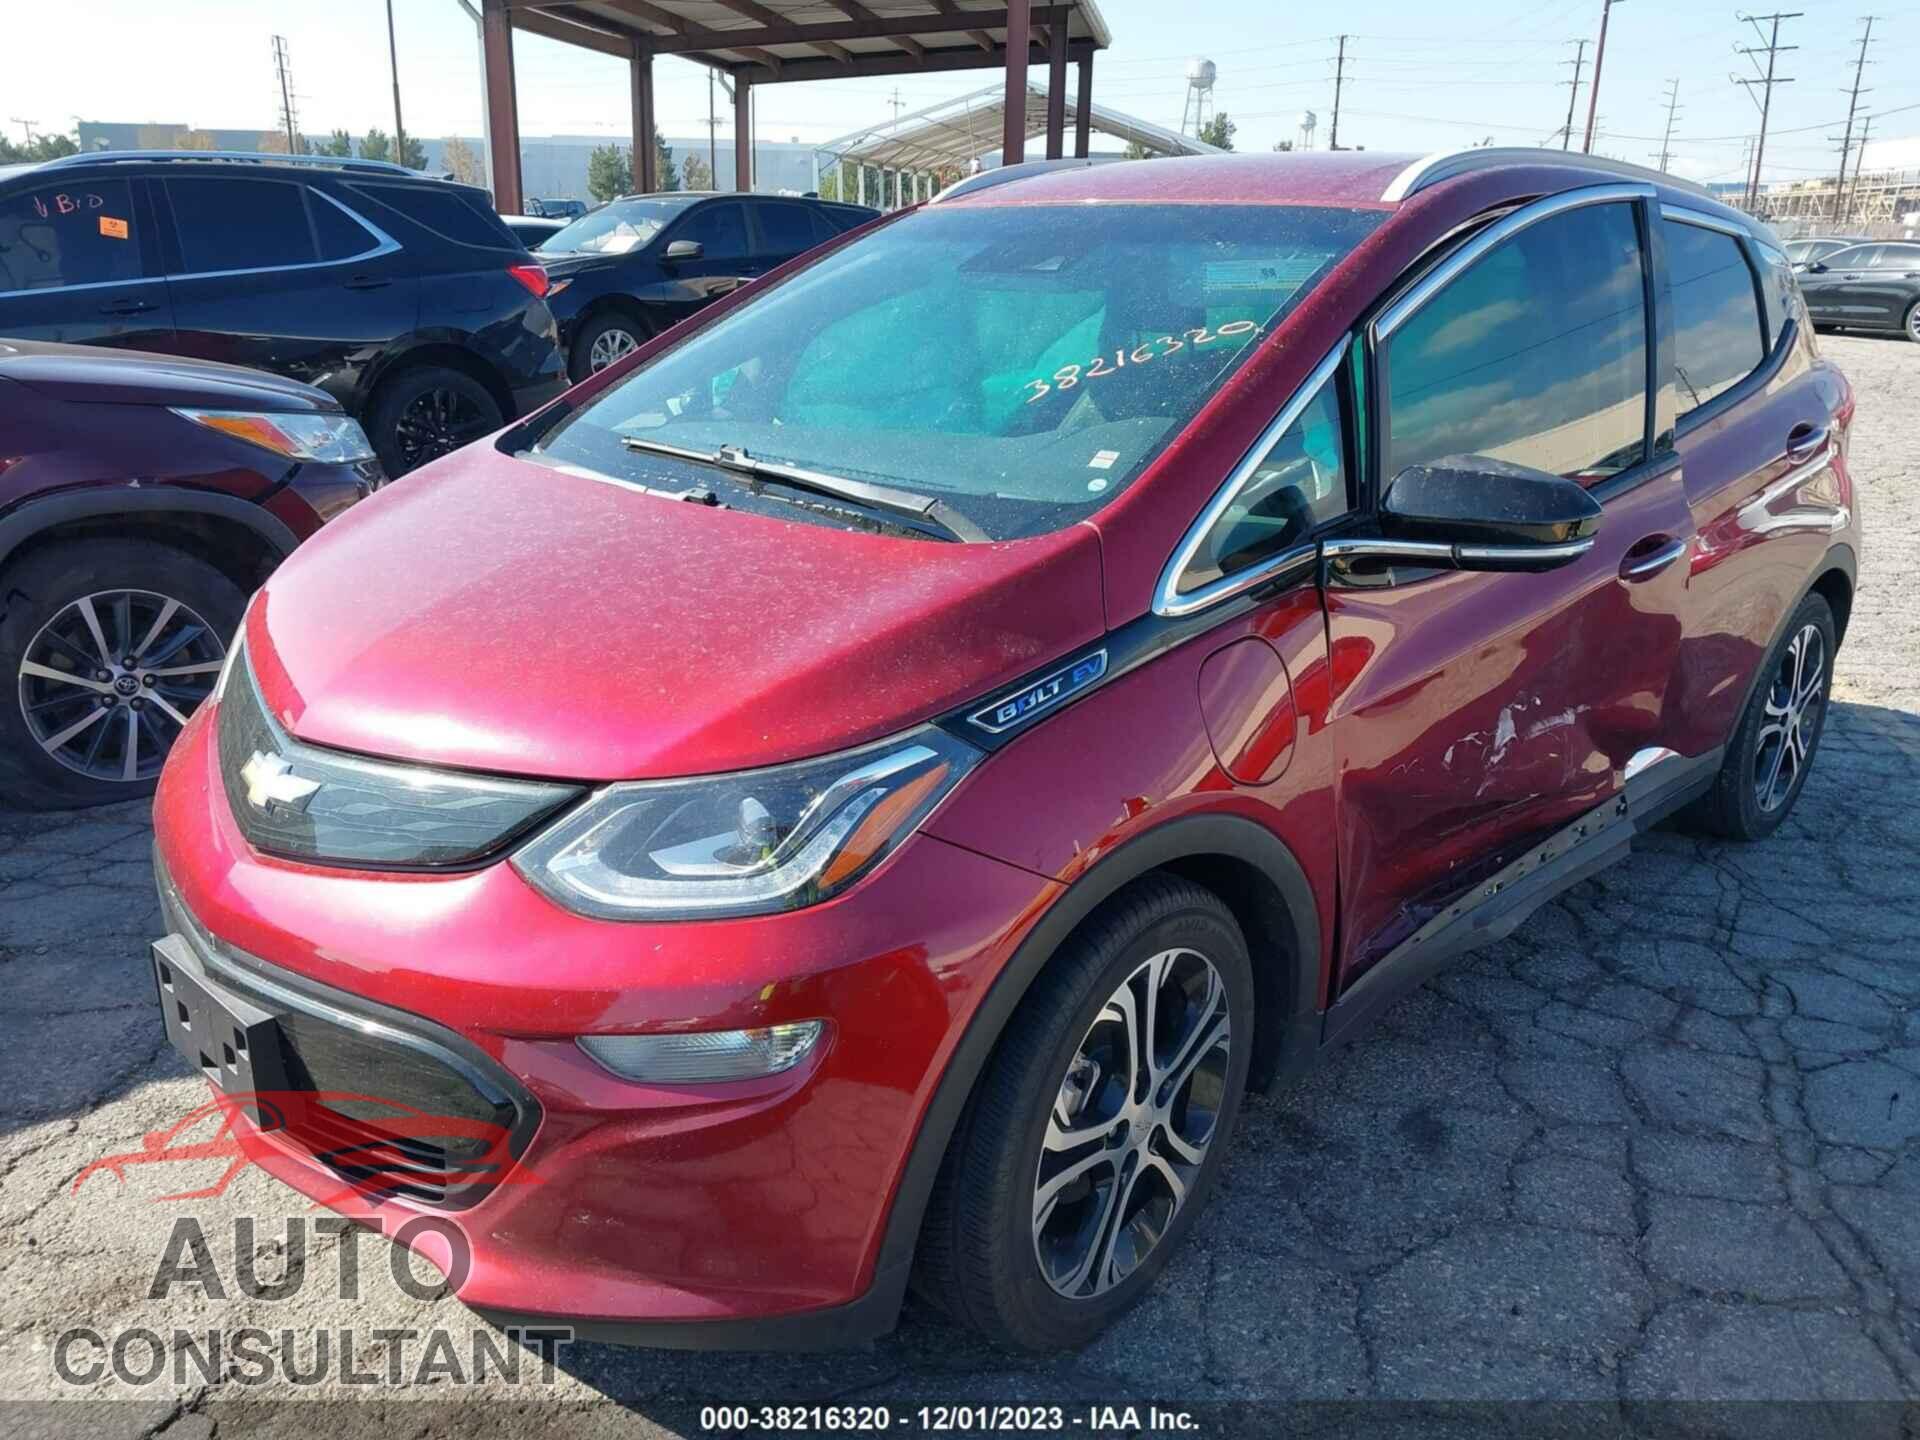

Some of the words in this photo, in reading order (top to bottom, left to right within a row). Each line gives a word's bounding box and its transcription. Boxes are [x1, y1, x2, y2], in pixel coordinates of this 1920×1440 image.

[1024, 320, 1256, 403] 38216320
[996, 677, 1064, 724] BOLT
[1072, 657, 1101, 683] EV
